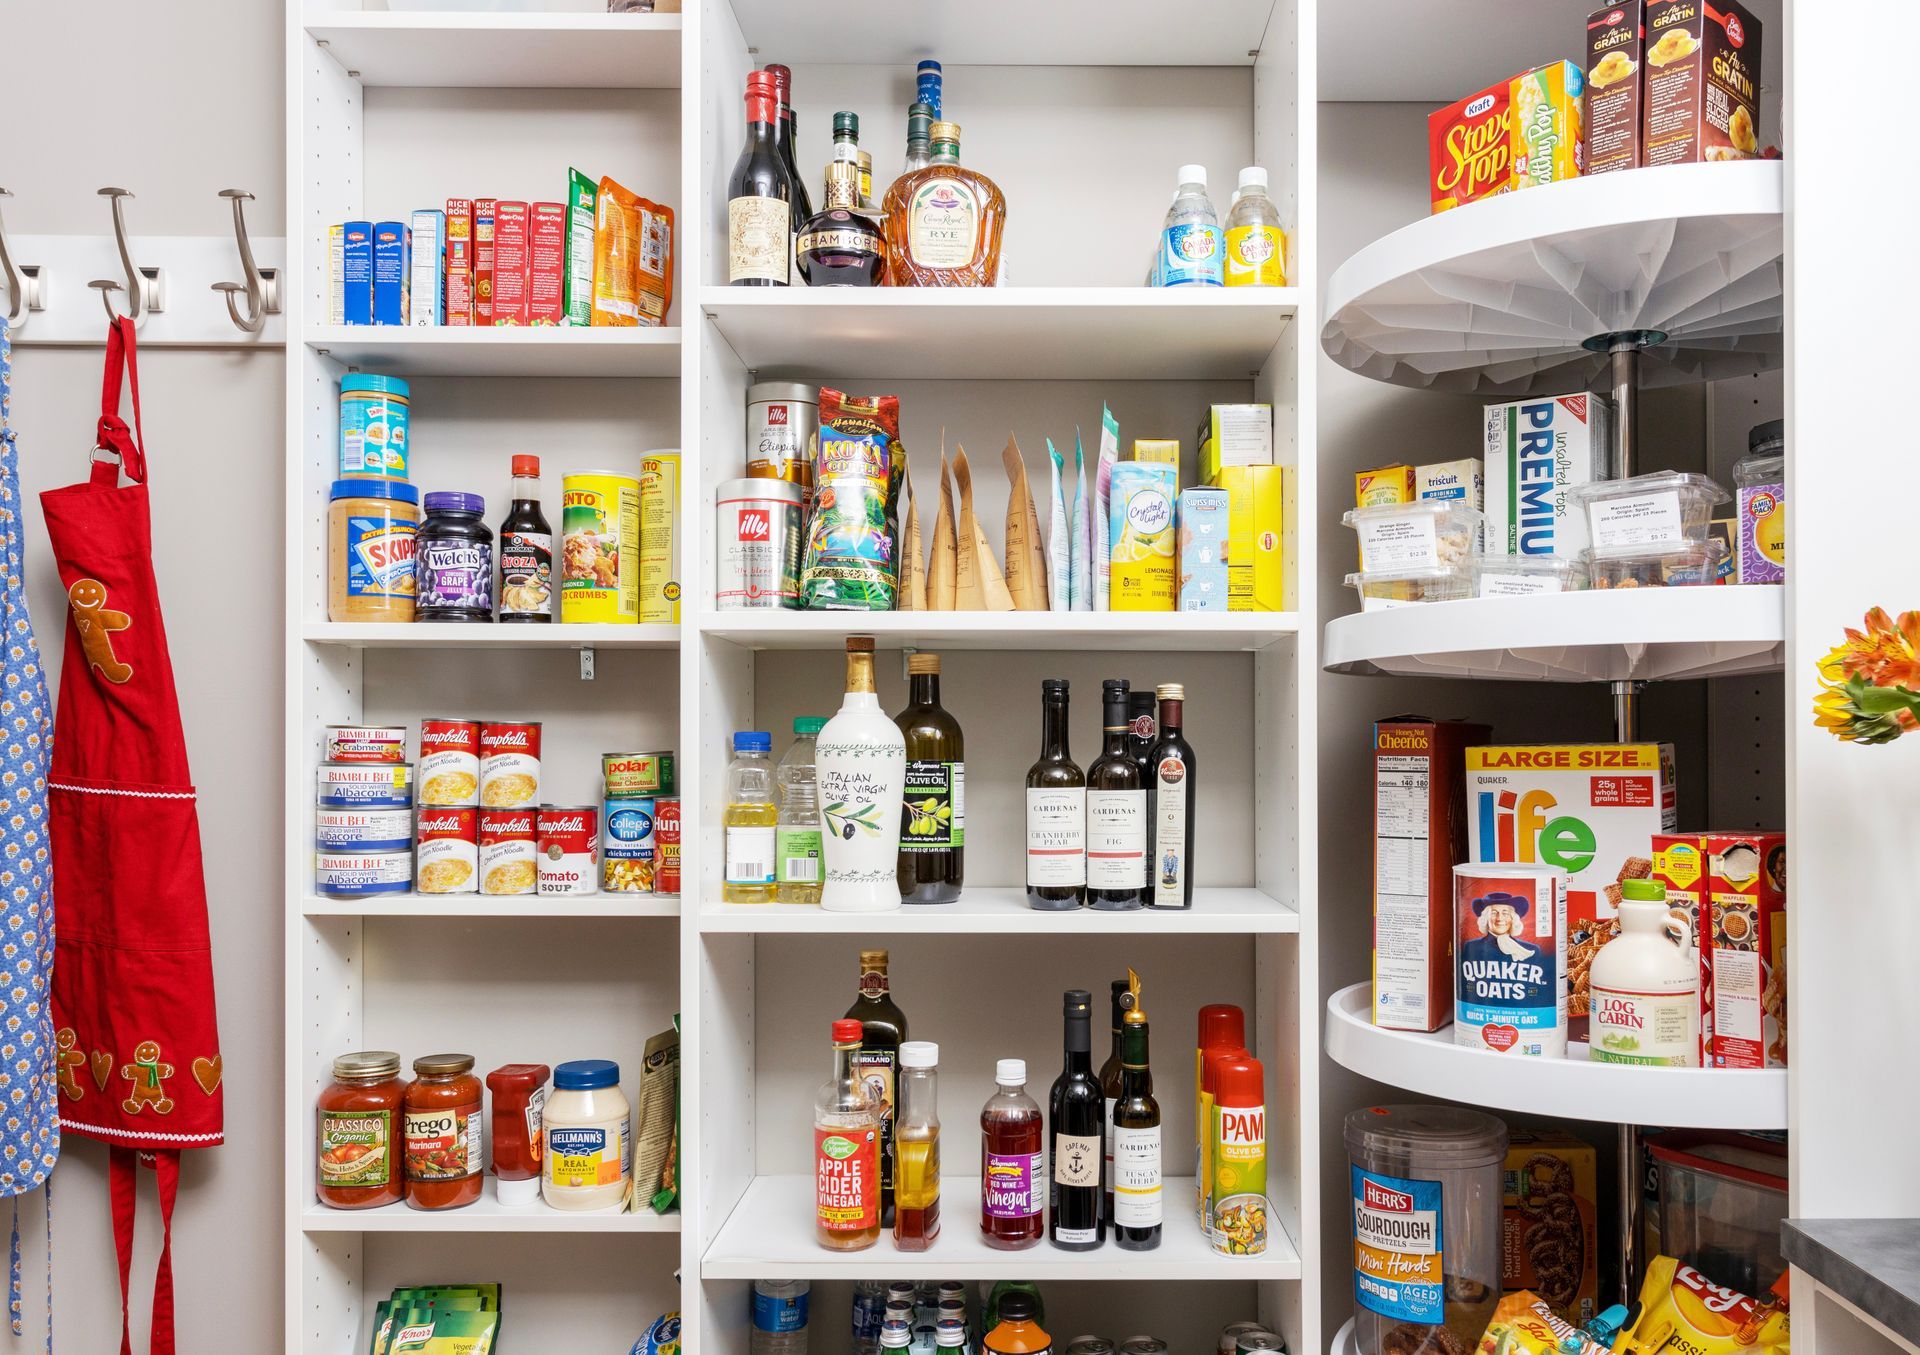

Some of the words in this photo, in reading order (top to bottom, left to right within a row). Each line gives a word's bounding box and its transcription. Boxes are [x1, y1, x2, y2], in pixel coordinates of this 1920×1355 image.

[1653, 8, 1694, 27] GRATIN
[1594, 31, 1632, 50] GRATIN
[1713, 57, 1753, 100] GRATIN
[1468, 100, 1490, 115] Kraft
[1463, 144, 1508, 197] Top
[770, 409, 786, 424] illy
[832, 419, 884, 432] Hawaiian
[823, 441, 885, 469] KONA
[1556, 432, 1571, 489] unsalted
[1428, 475, 1458, 487] triscuit
[1520, 403, 1554, 555] PREMIU
[563, 493, 595, 506] ENTO
[1429, 490, 1457, 498] ORIGINAL
[1556, 490, 1567, 517] tops
[1752, 499, 1772, 509] FAMILY
[1754, 506, 1772, 514] PACK
[1130, 500, 1163, 522] Crystal
[740, 513, 767, 537] illy
[369, 538, 416, 568] SKIPP
[432, 550, 479, 567] Welch's
[502, 554, 537, 568] GYOZA
[441, 575, 468, 587] GRAPE
[569, 591, 607, 599] CRUMBS
[1378, 734, 1428, 748] Cheerios
[343, 744, 384, 752] Crabmeat
[440, 757, 462, 767] Noodle
[500, 759, 520, 770] Noodle
[1482, 751, 1570, 767] LARGE
[1578, 751, 1639, 767] SIZE
[608, 761, 650, 775] polar
[912, 761, 940, 771] Wegmans
[329, 772, 370, 782] BUMBLE
[373, 772, 390, 782] BEE
[827, 771, 872, 783] ITALIAN
[1477, 776, 1509, 784] QUAKER
[821, 781, 848, 791] EXTRA
[853, 784, 887, 793] VIRGIN
[1598, 781, 1615, 789] 25g
[335, 788, 387, 797] Albacore
[825, 793, 849, 802] OLIVE
[1595, 794, 1618, 803] grains
[348, 816, 366, 825] BEE
[482, 816, 532, 832] Campbell's
[610, 818, 649, 831] College
[655, 816, 680, 831] Hun
[320, 832, 362, 840] Albacore
[620, 829, 637, 838] Inn
[1478, 789, 1596, 874] life
[504, 846, 525, 856] Noodle
[323, 859, 359, 868] BUMBLE
[363, 859, 381, 868] BEE
[327, 875, 378, 884] Albacore
[539, 869, 579, 882] Tomato
[542, 884, 572, 892] SOUP
[1462, 960, 1543, 985] QUAKER
[1476, 981, 1525, 1000] OATS
[1604, 999, 1635, 1014] LOG
[1466, 1010, 1484, 1021] QUICK
[1486, 1014, 1519, 1024] 1-MINUTE
[1521, 1015, 1538, 1024] OATS
[1599, 1012, 1644, 1029] CABIN
[1609, 1055, 1653, 1066] NATURAL
[324, 1119, 382, 1131] CLASSICO
[405, 1116, 451, 1139] Prego
[1223, 1113, 1264, 1141] PAM
[331, 1132, 371, 1142] Organic
[552, 1132, 602, 1144] HELLMANN'S
[409, 1141, 442, 1150] Marinara
[1065, 1143, 1078, 1151] CAPE
[1080, 1143, 1090, 1153] MAY
[819, 1158, 861, 1176] APPLE
[819, 1175, 861, 1194] CIDER
[819, 1192, 861, 1207] VINEGAR
[986, 1187, 1030, 1210] Vinegar
[1367, 1187, 1407, 1210] HERR'S
[1357, 1207, 1430, 1240] SOURDOUGH
[1373, 1236, 1407, 1248] PRETZELS
[1504, 1217, 1517, 1279] Sourdough
[1358, 1247, 1384, 1271] Mini
[1387, 1253, 1432, 1275] Hards
[1404, 1288, 1437, 1300] AGED
[1410, 1304, 1428, 1313] RECIPE
[400, 1328, 433, 1343] Knorr
[453, 1342, 486, 1353] Vegetable
